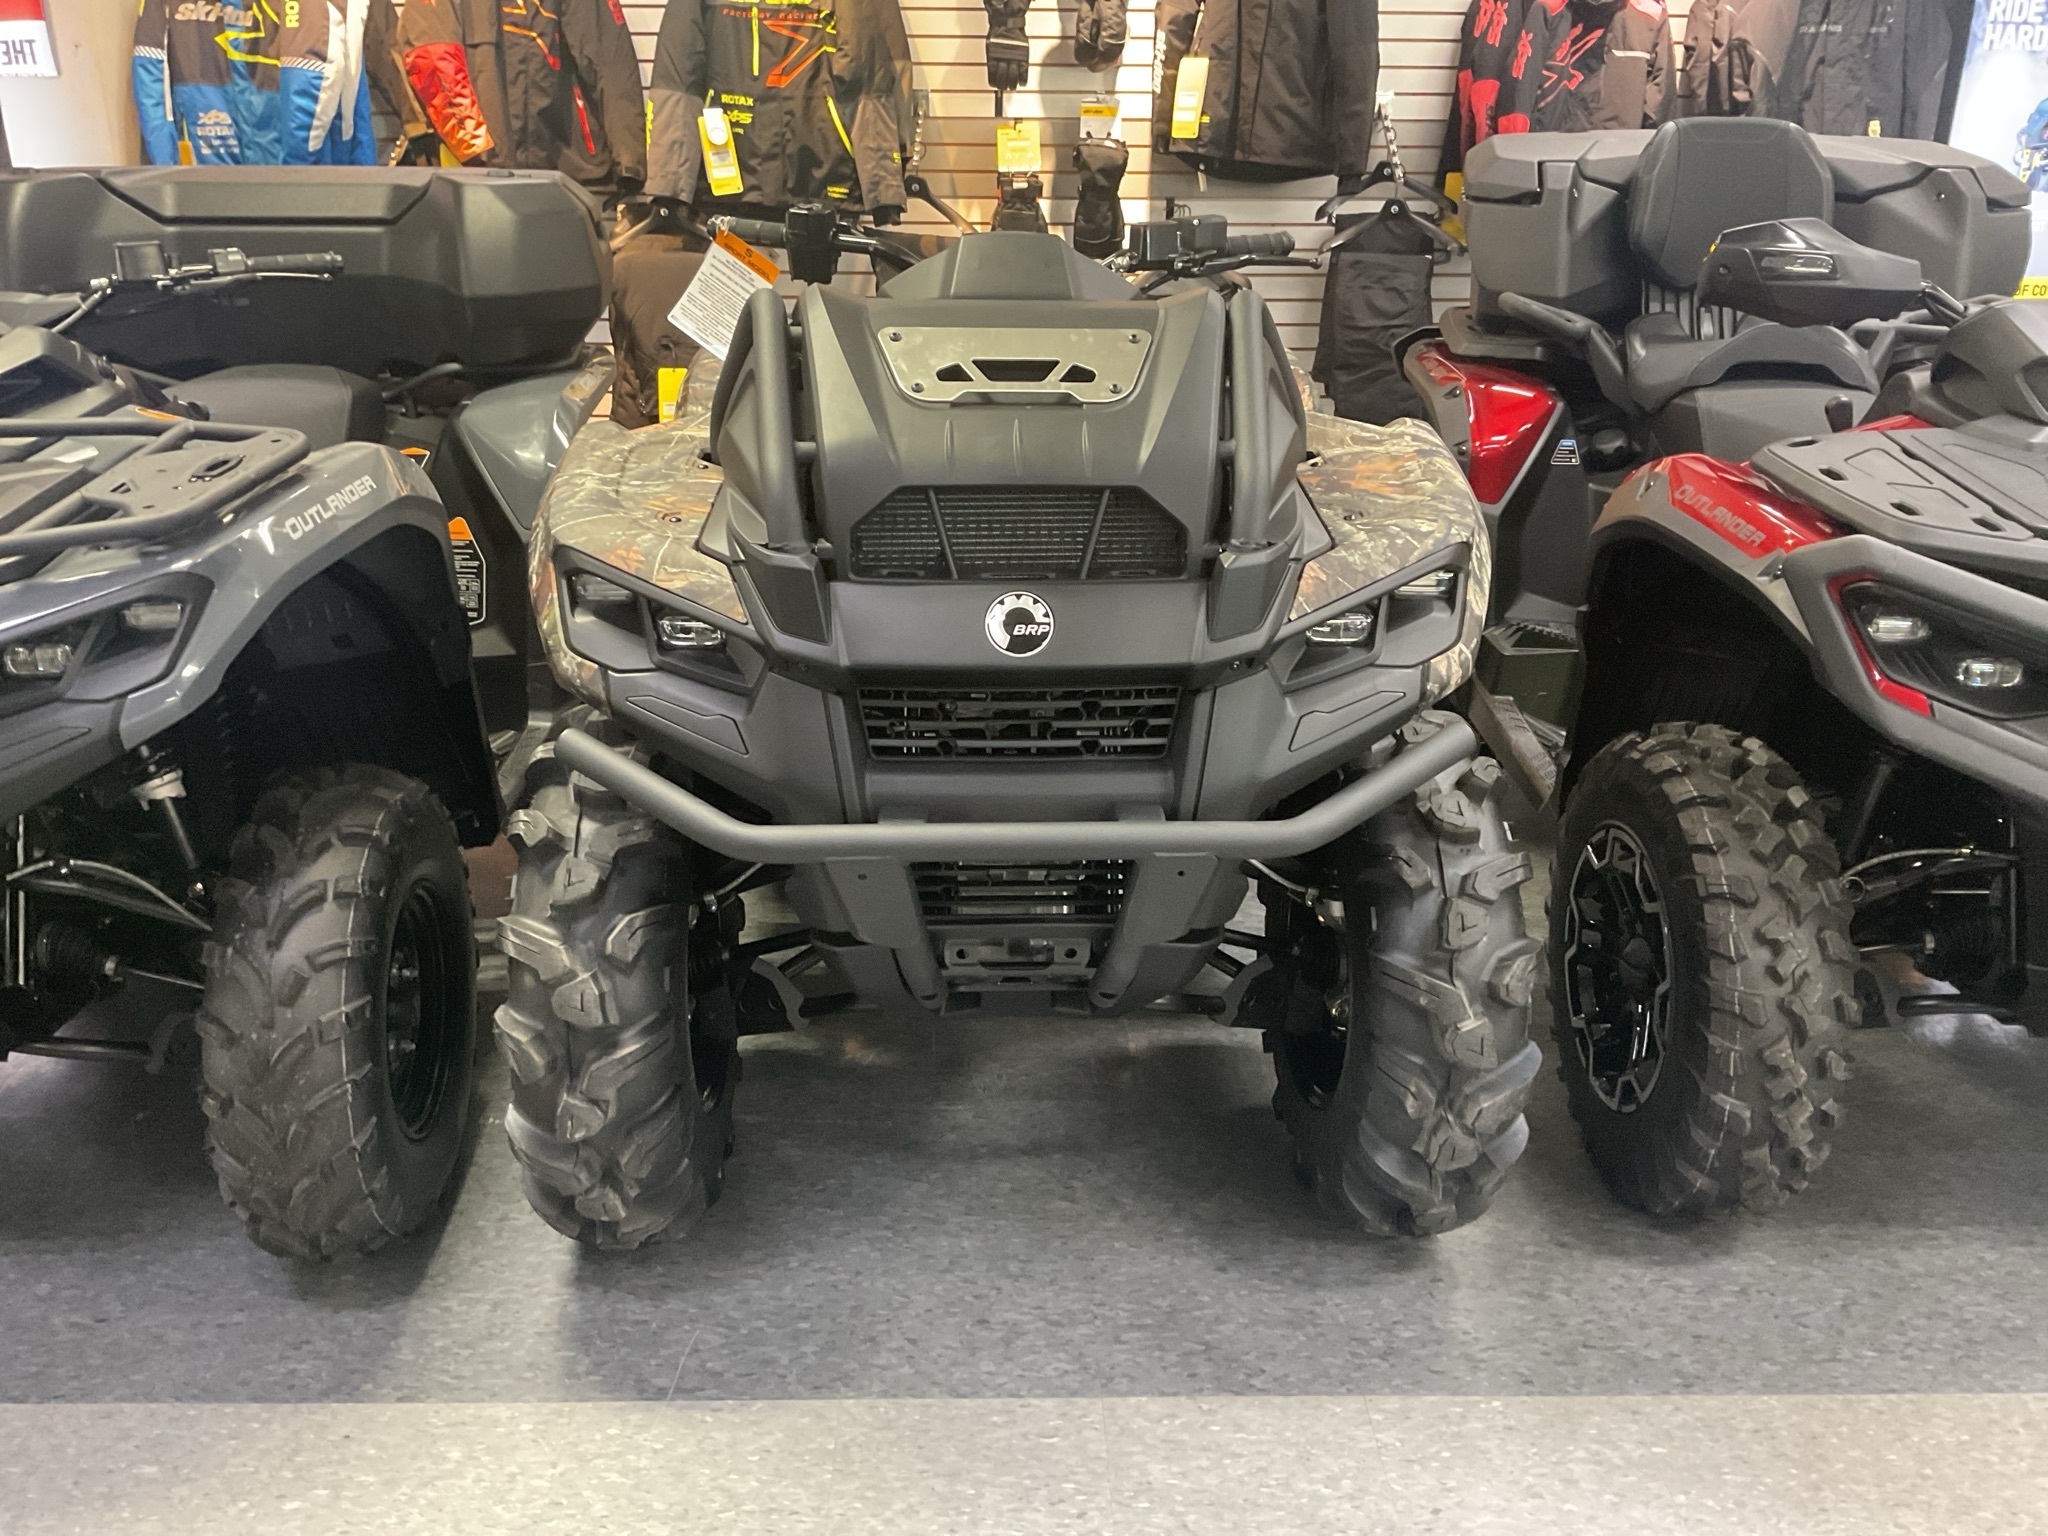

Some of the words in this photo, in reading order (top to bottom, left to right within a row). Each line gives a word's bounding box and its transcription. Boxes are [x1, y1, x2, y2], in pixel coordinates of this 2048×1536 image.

[285, 0, 300, 28] RO
[1988, 0, 2047, 22] RIDE
[1983, 23, 2048, 51] HARD
[721, 94, 754, 106] ROTAX
[744, 248, 754, 258] S
[285, 475, 377, 540] OUTLANDER
[1674, 484, 1766, 547] OUTLANDER
[1013, 624, 1050, 636] BRP
